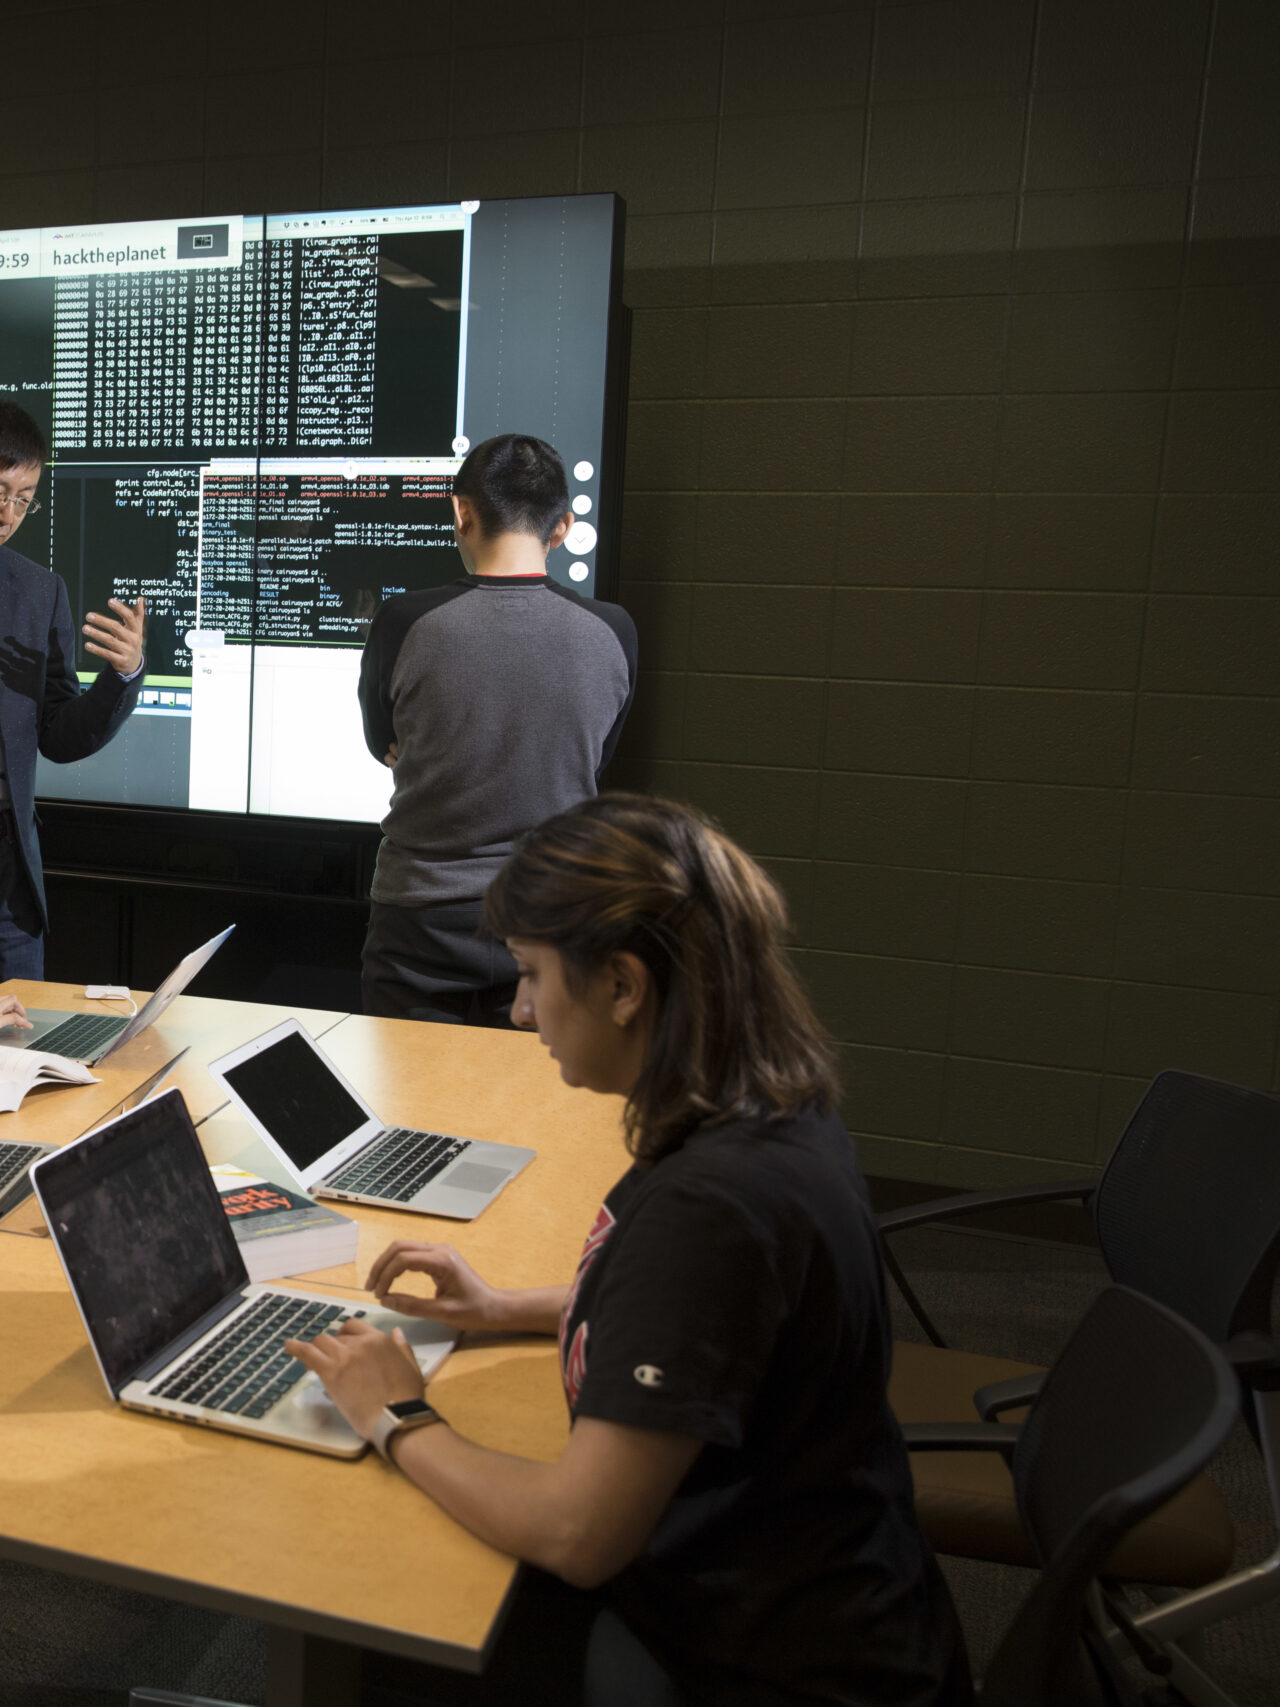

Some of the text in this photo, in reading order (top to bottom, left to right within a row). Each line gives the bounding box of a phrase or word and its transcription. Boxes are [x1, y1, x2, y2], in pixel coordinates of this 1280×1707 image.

[53, 246, 167, 266] hacktheplanet
[147, 469, 202, 478] cfg.node[src_
[115, 479, 139, 488] #print
[143, 479, 186, 488] control_ea,
[382, 586, 406, 594] include
